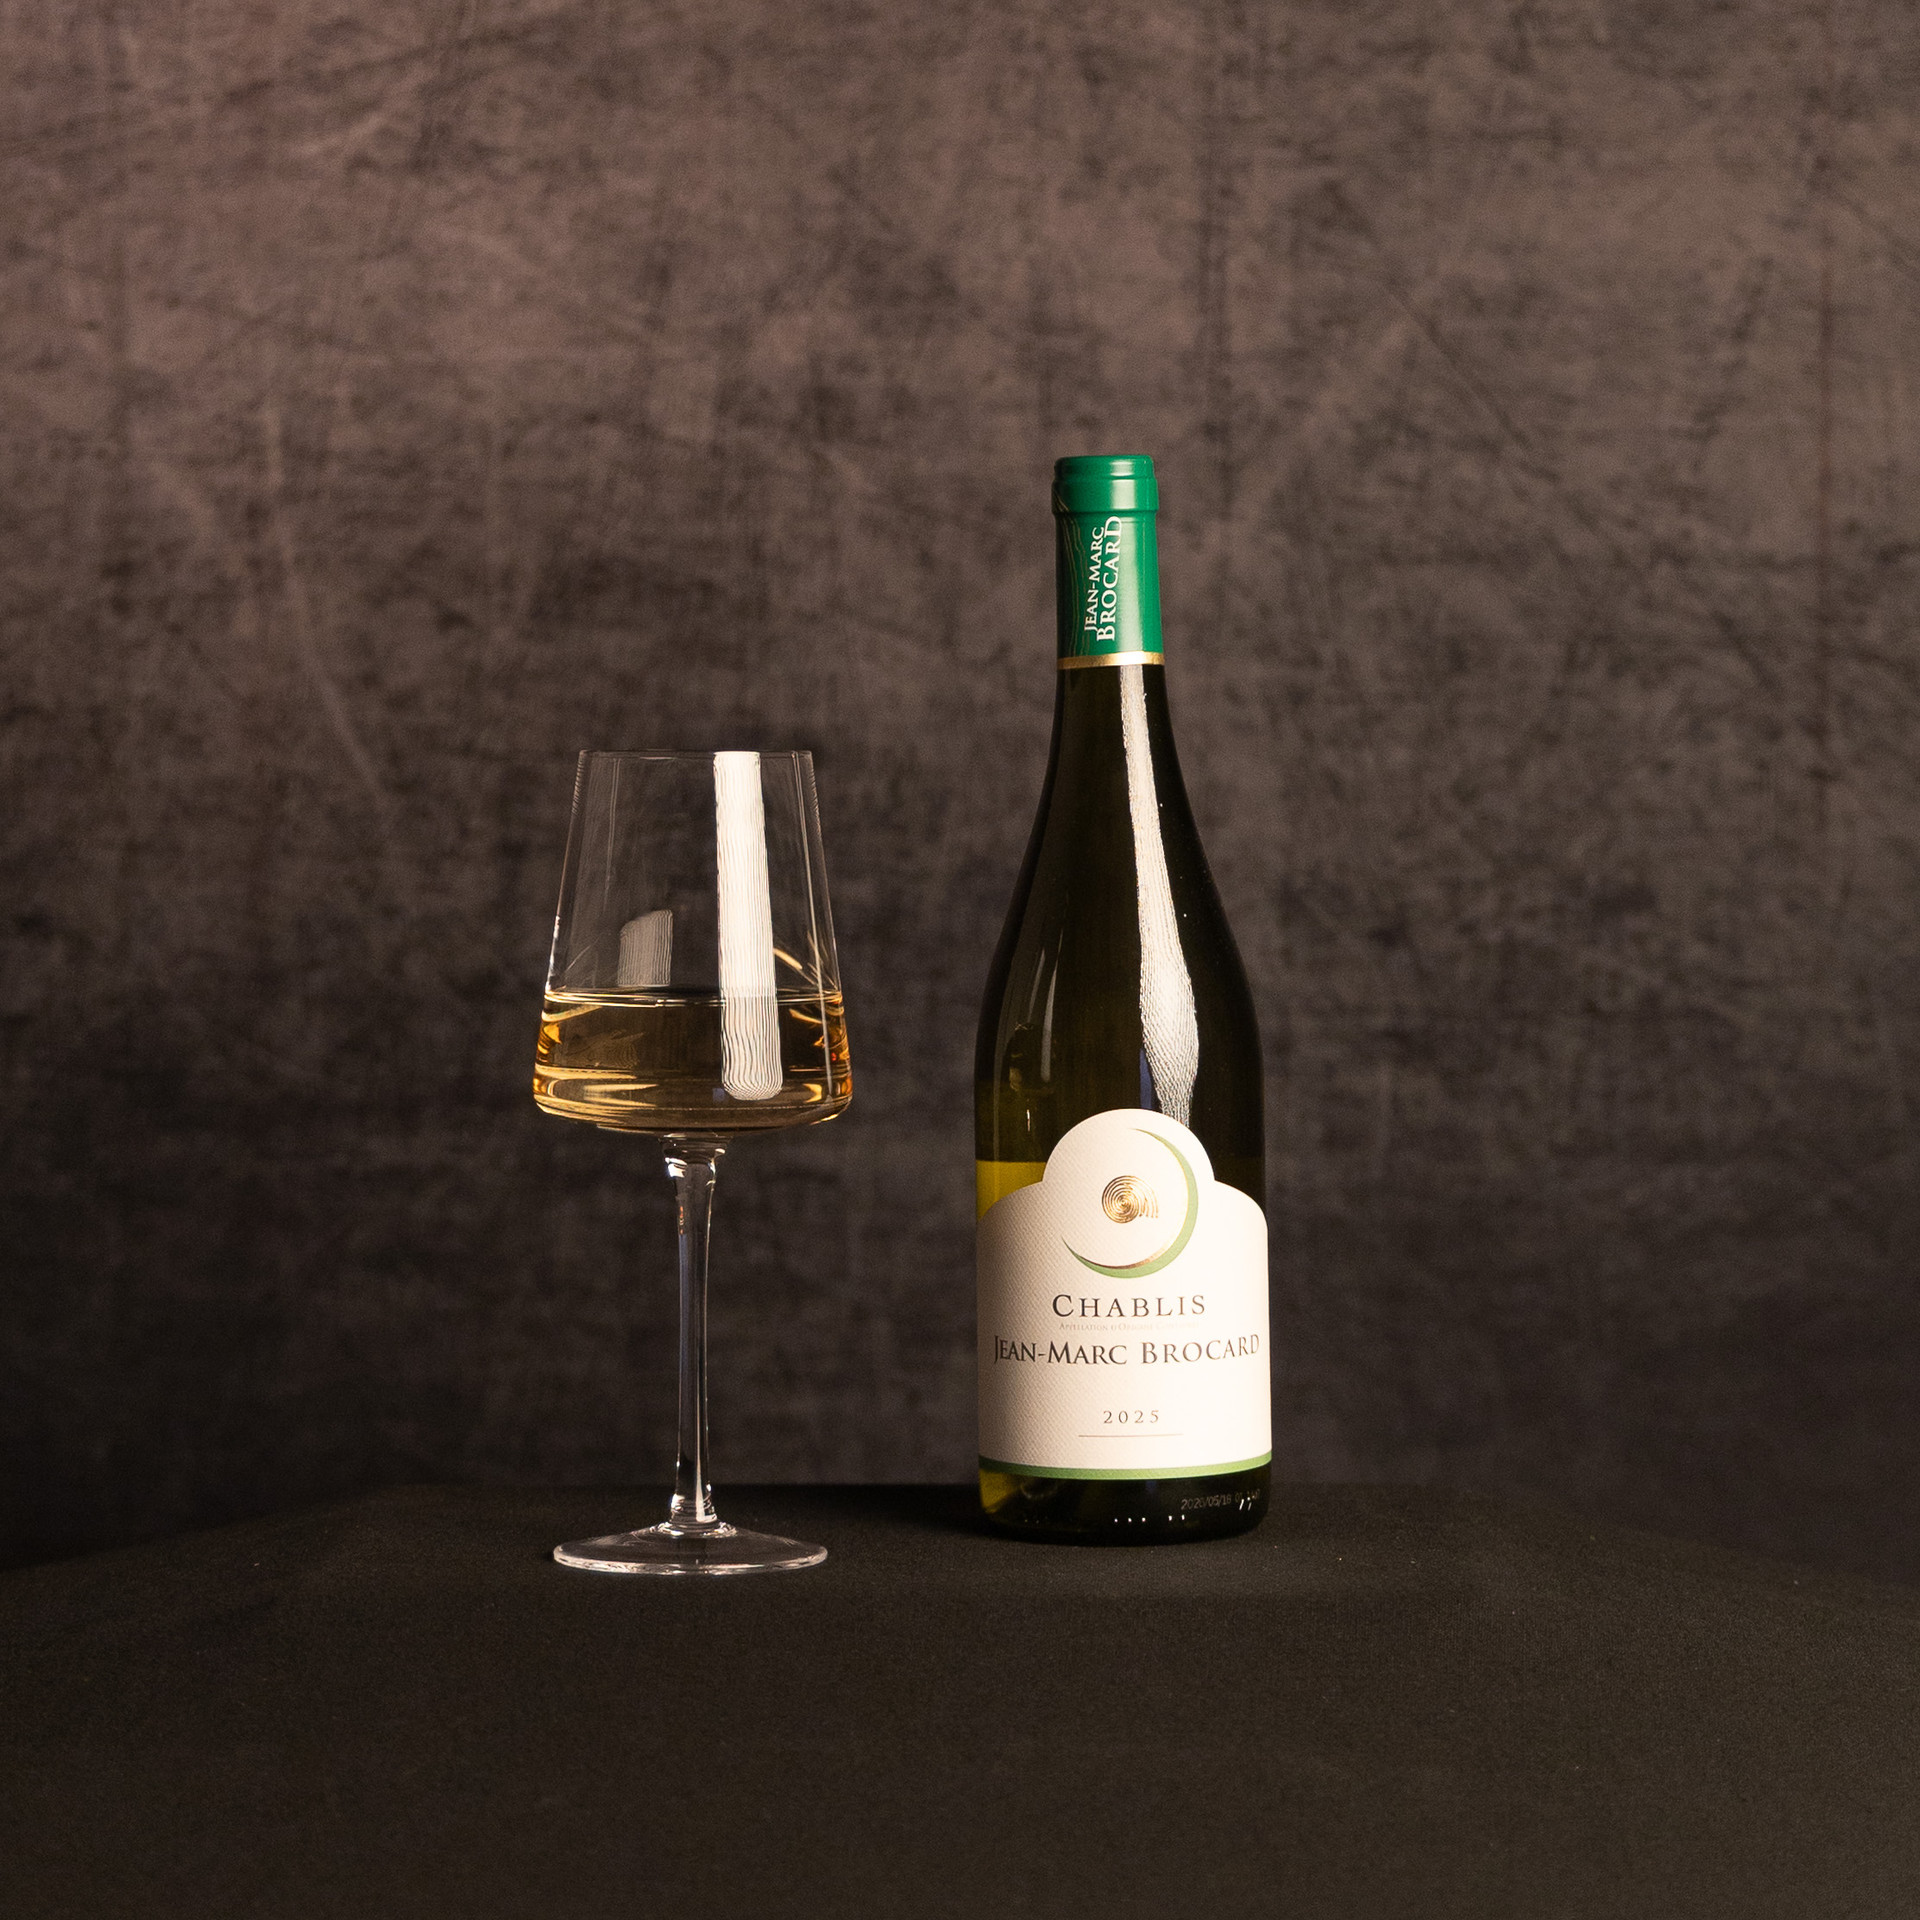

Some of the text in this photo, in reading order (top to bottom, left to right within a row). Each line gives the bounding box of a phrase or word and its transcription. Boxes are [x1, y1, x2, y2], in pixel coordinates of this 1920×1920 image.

[1084, 526, 1105, 632] JEAN-MARC
[1096, 515, 1122, 642] BROCARD
[1052, 1294, 1206, 1318] CHABLIS
[993, 1333, 1260, 1366] JEAN-MARC BROCARD
[1102, 1409, 1160, 1424] 2025
